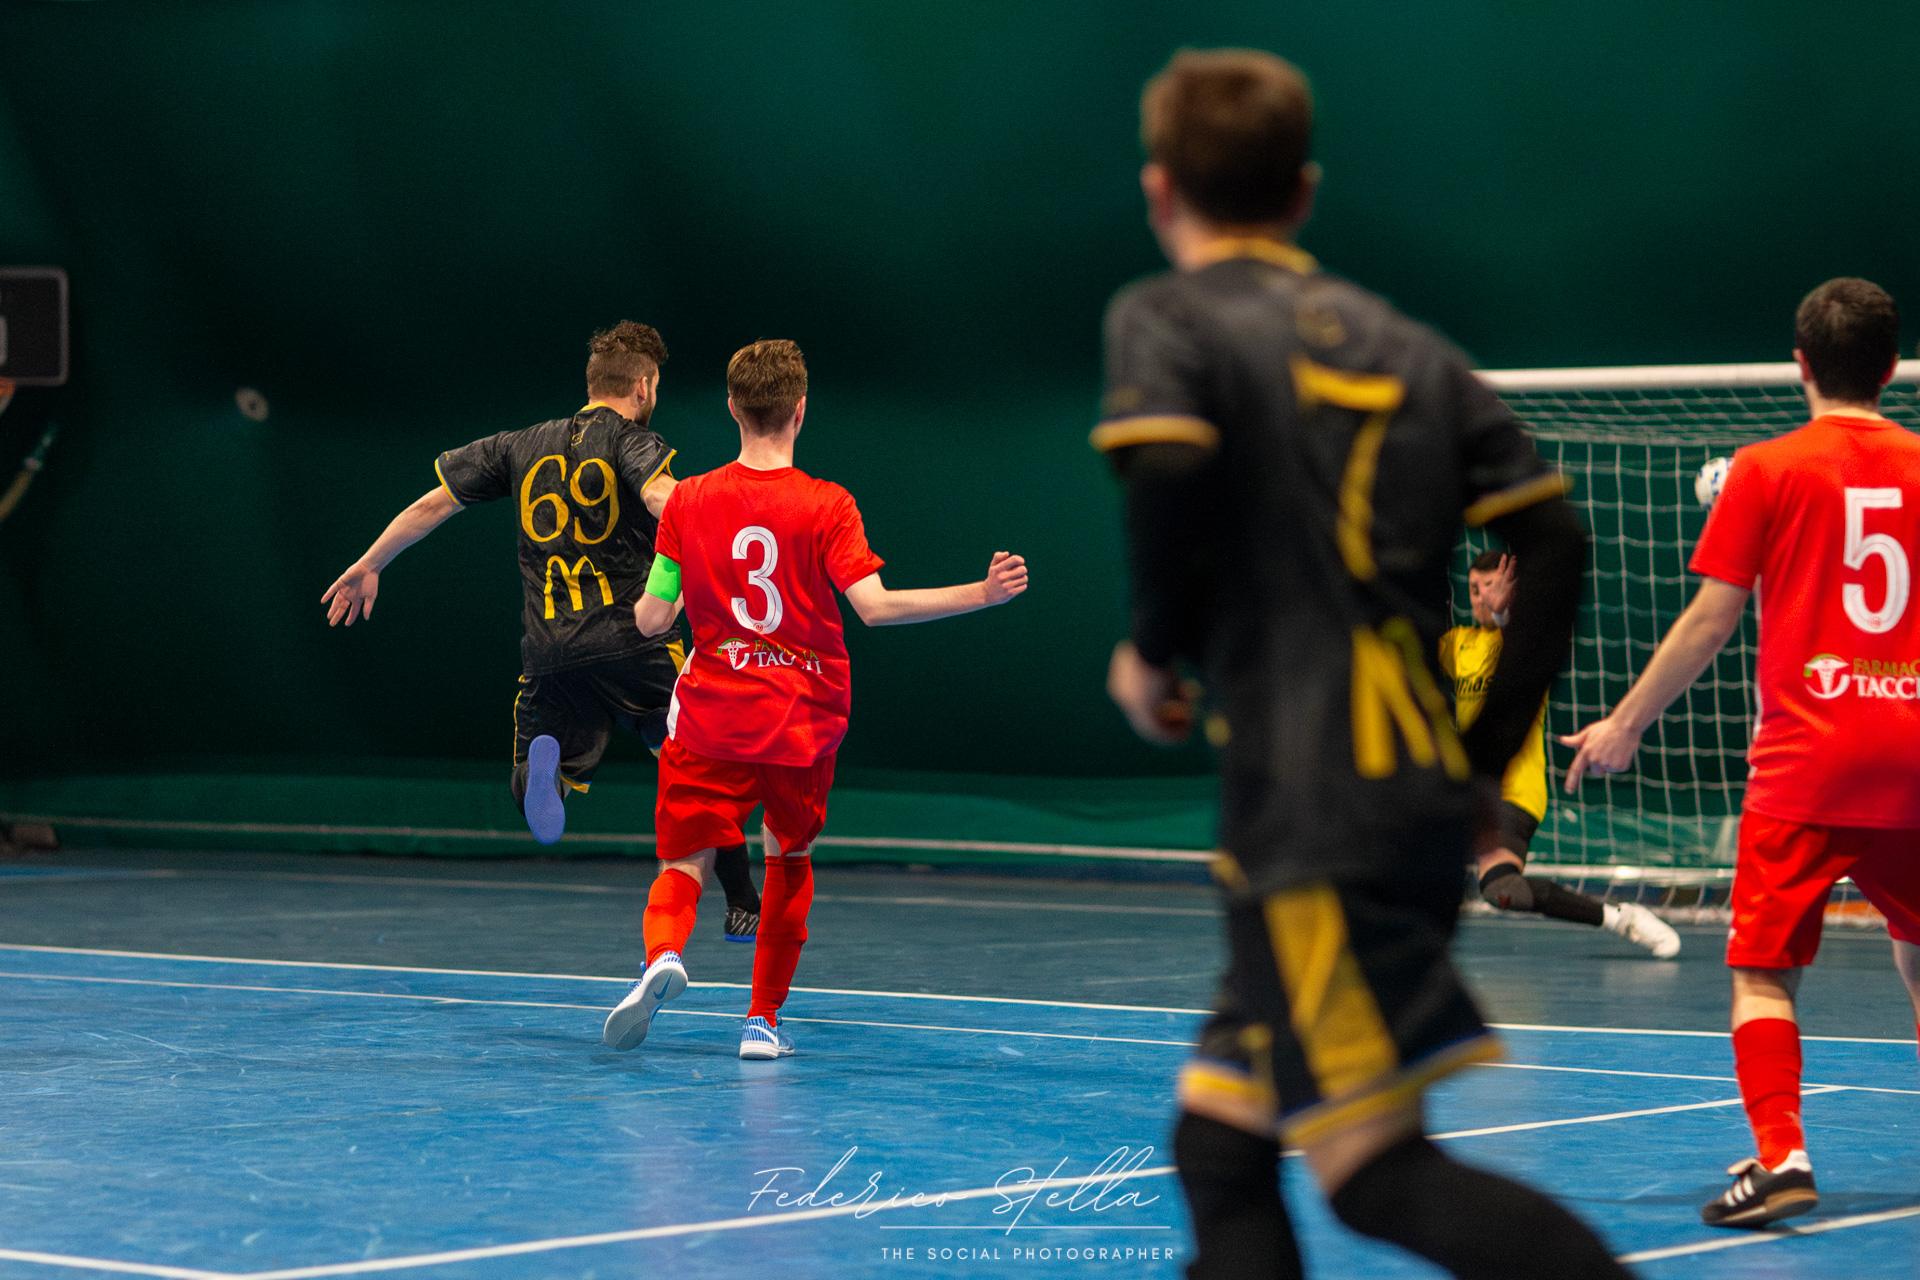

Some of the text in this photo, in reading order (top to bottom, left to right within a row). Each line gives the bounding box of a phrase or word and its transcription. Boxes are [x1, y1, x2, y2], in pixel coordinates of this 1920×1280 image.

[520, 454, 619, 545] 69
[1289, 354, 1405, 582] 7
[731, 526, 783, 634] 3
[1842, 487, 1910, 634] 5
